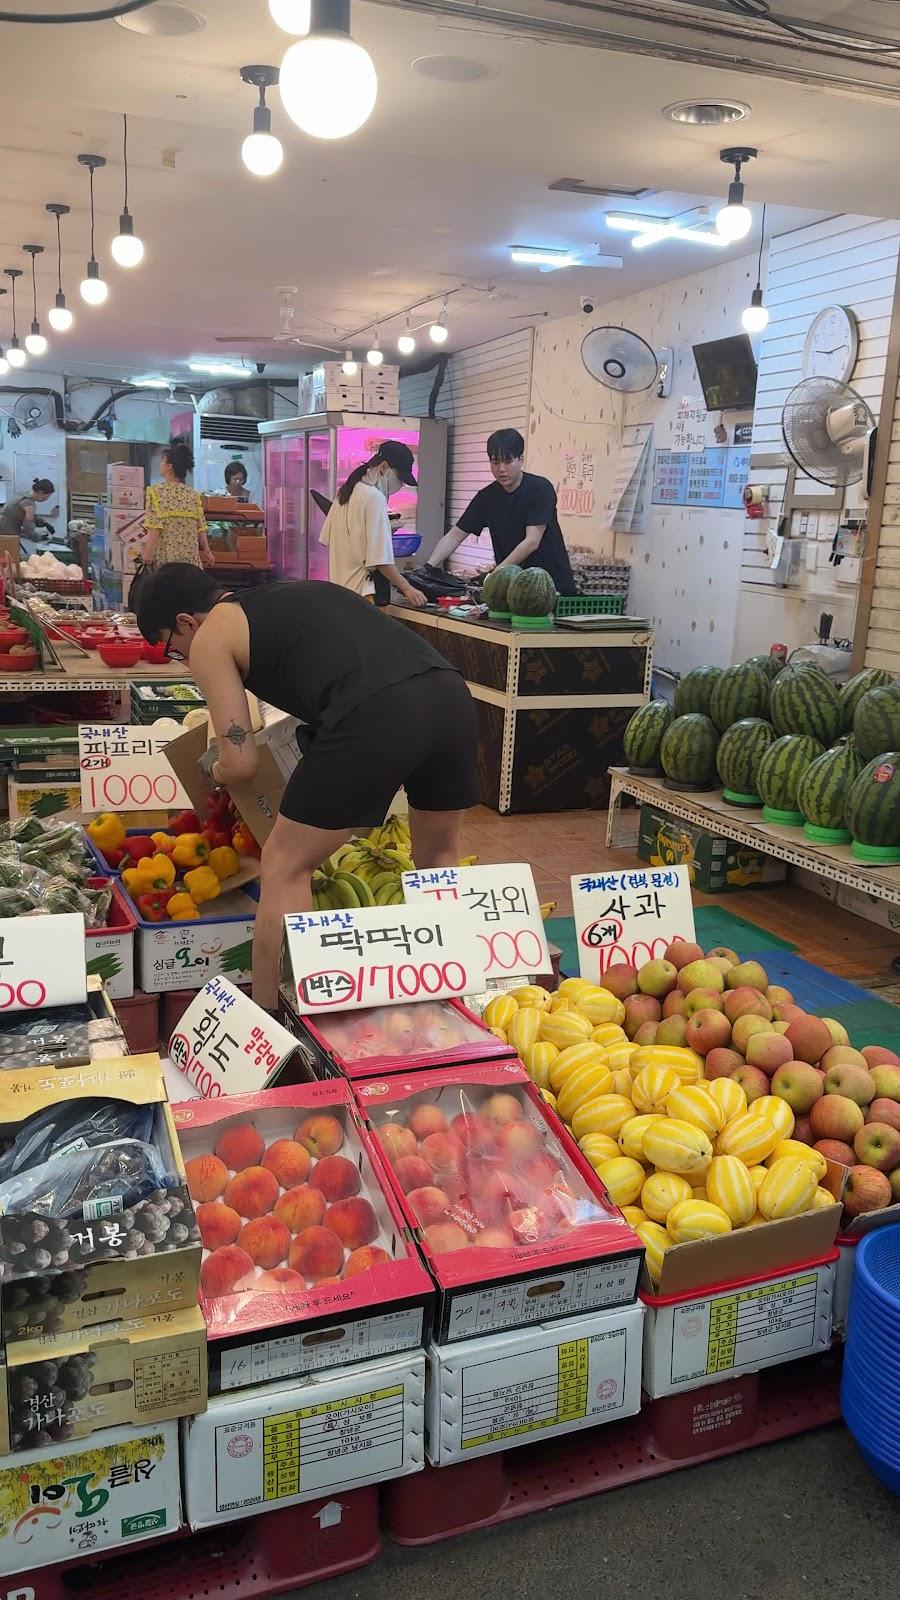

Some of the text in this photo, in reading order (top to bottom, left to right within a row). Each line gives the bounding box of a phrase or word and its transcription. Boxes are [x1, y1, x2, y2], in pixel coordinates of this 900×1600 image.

[80, 727, 128, 739] 국내산
[82, 757, 110, 769] 2개
[405, 869, 458, 888] 국내산
[462, 886, 530, 921] 참외
[600, 891, 666, 921] 사과
[287, 912, 354, 933] 국내산
[320, 924, 443, 956] 딱딱이
[587, 923, 618, 946] 6개
[153, 947, 209, 970] 싱글 오이
[204, 978, 236, 1014] 국내산
[243, 1026, 281, 1075] 말랑이
[71, 1223, 127, 1247] 거봉
[455, 1306, 473, 1320] 20
[18, 1325, 45, 1335] 2kg
[24, 1392, 57, 1412] 경산
[325, 1403, 375, 1420] 오이(가시오이)
[23, 1401, 108, 1431] 가나포도
[341, 1435, 360, 1444] 10kg
[280, 1459, 297, 1468] 주소
[30, 1459, 156, 1518] 싱글 오이
